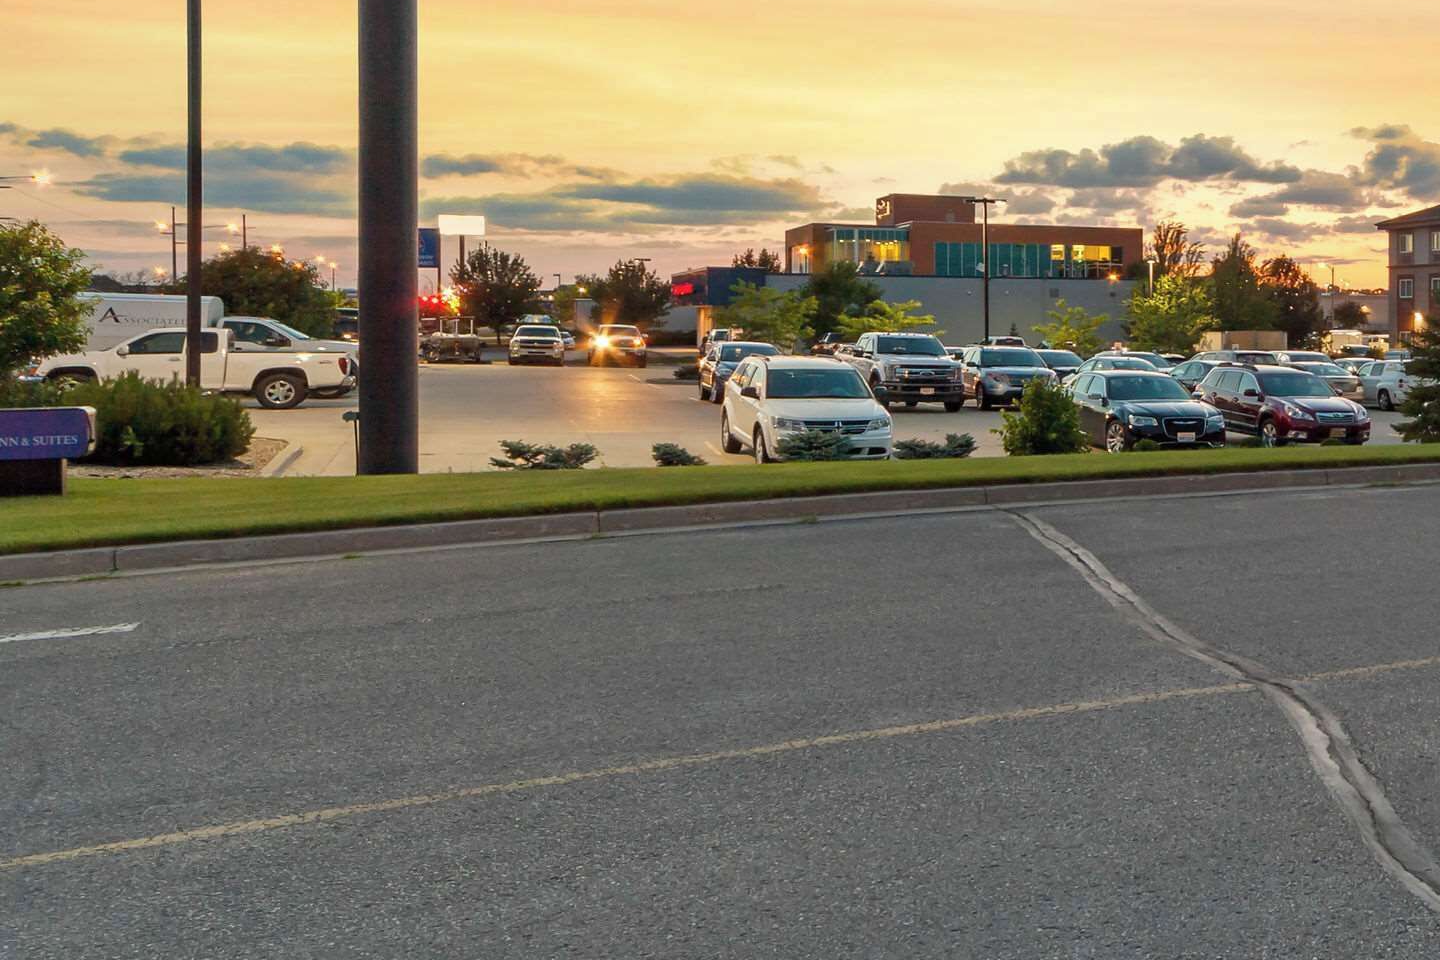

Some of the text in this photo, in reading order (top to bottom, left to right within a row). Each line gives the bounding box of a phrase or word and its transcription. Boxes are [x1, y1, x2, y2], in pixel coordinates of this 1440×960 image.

[0, 434, 79, 448] NN & SUITES
